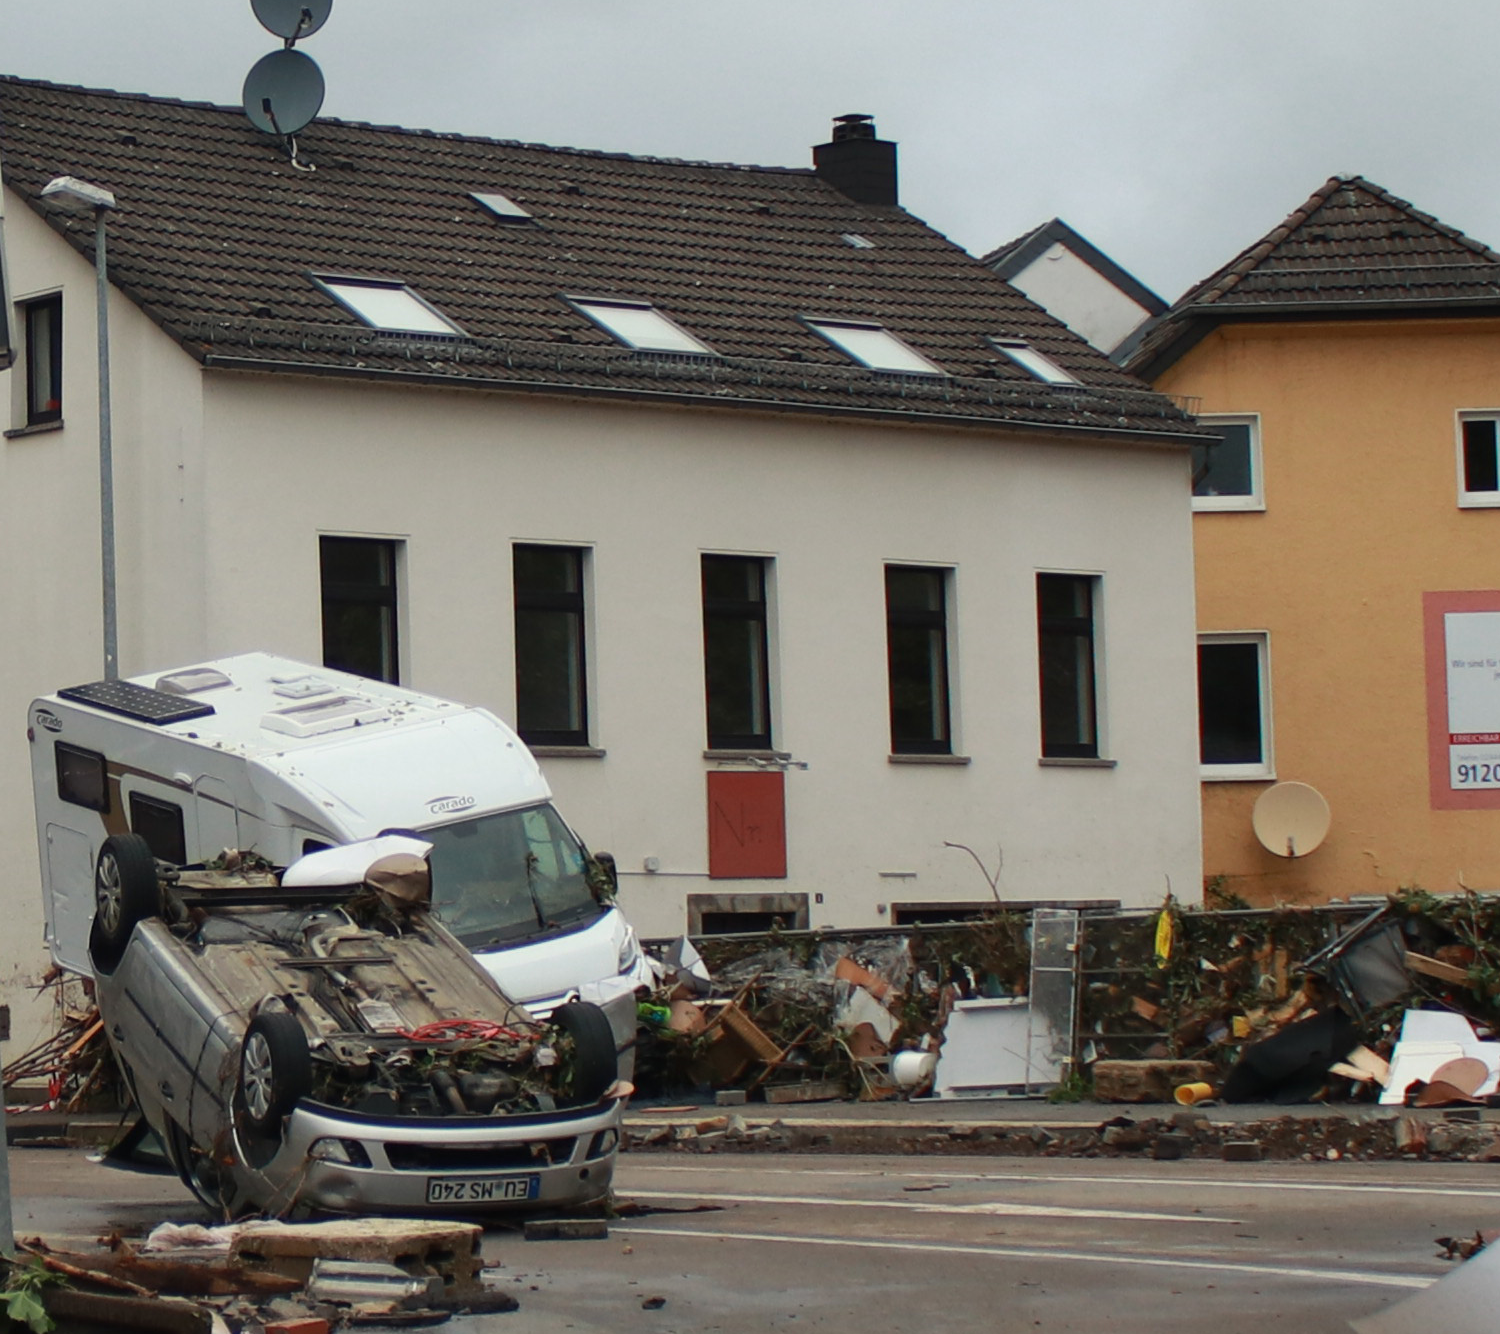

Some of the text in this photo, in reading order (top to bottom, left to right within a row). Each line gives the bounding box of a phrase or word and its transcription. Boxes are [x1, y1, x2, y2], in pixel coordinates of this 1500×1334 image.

[1453, 733, 1500, 743] ERREICHBAR
[431, 1180, 528, 1200] EU MS 240
